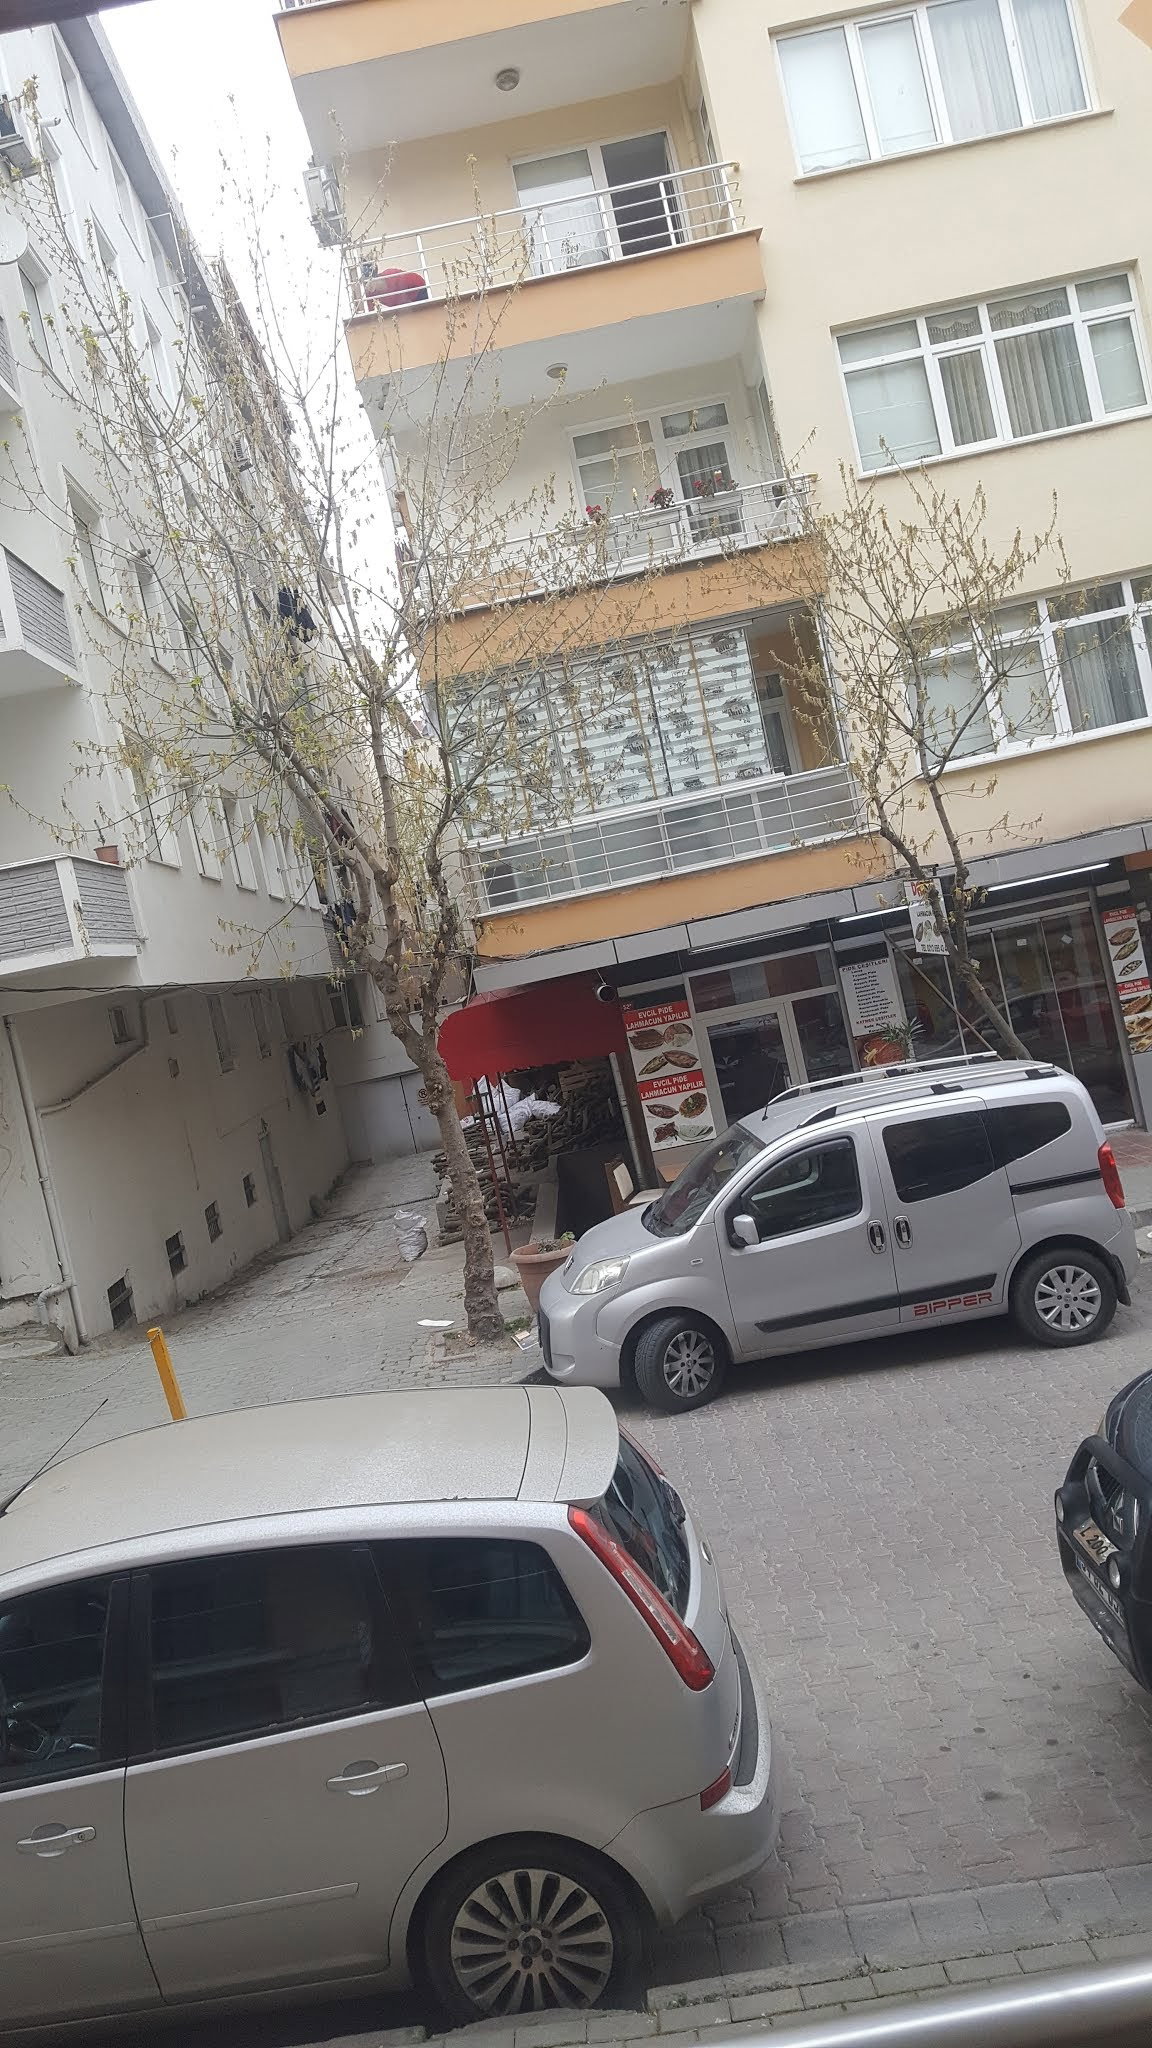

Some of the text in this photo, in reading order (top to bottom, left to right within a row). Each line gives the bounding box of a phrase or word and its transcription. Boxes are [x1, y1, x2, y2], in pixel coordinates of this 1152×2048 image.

[626, 1011, 688, 1030] LAHMACUN YAPILIR
[641, 1081, 703, 1099] LAHMACUN YAPILIR
[914, 1292, 992, 1316] BIPPER
[1086, 1535, 1108, 1555] 200
